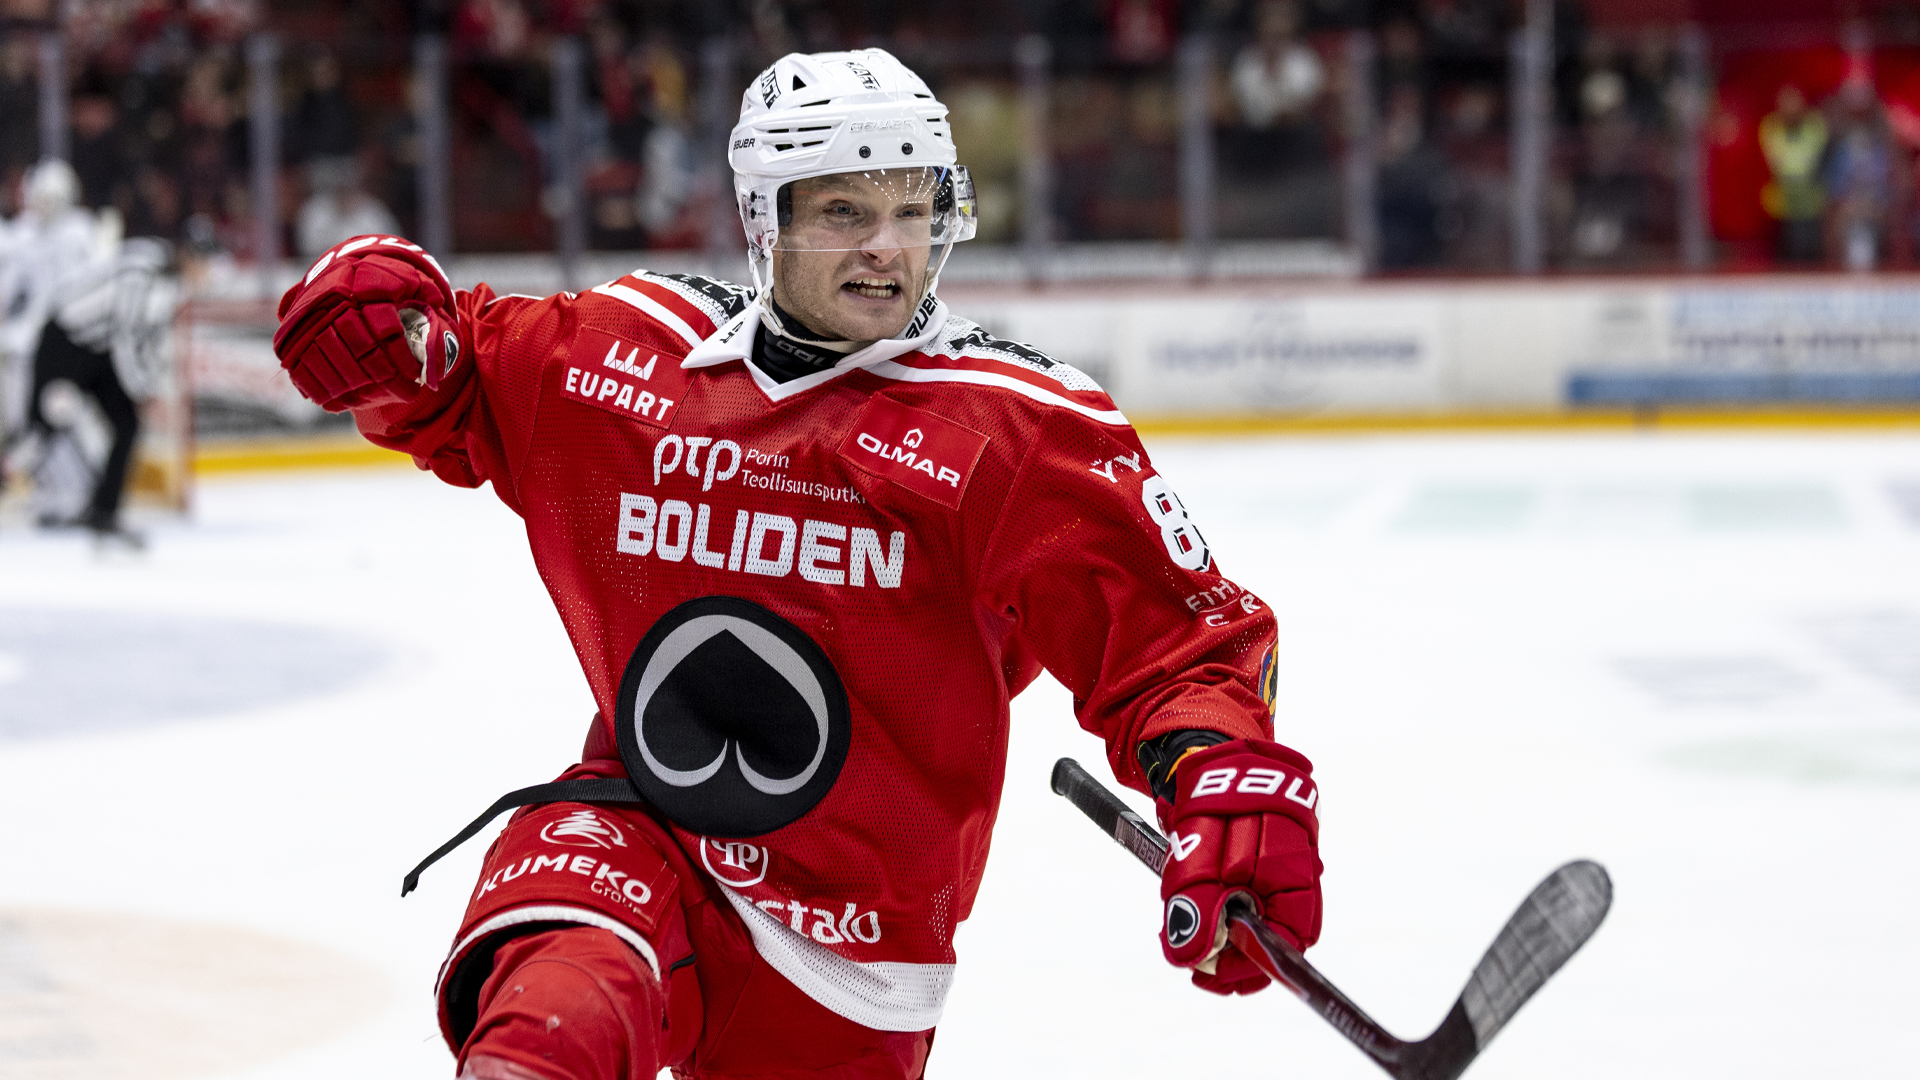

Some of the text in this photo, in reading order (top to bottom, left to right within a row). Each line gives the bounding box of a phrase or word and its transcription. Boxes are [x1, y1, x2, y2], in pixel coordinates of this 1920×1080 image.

[565, 367, 674, 421] EUPART
[745, 448, 790, 469] Porin
[857, 432, 961, 488] OLMAR
[616, 492, 906, 589] BOLIDEN
[477, 853, 652, 905] KUMEKO
